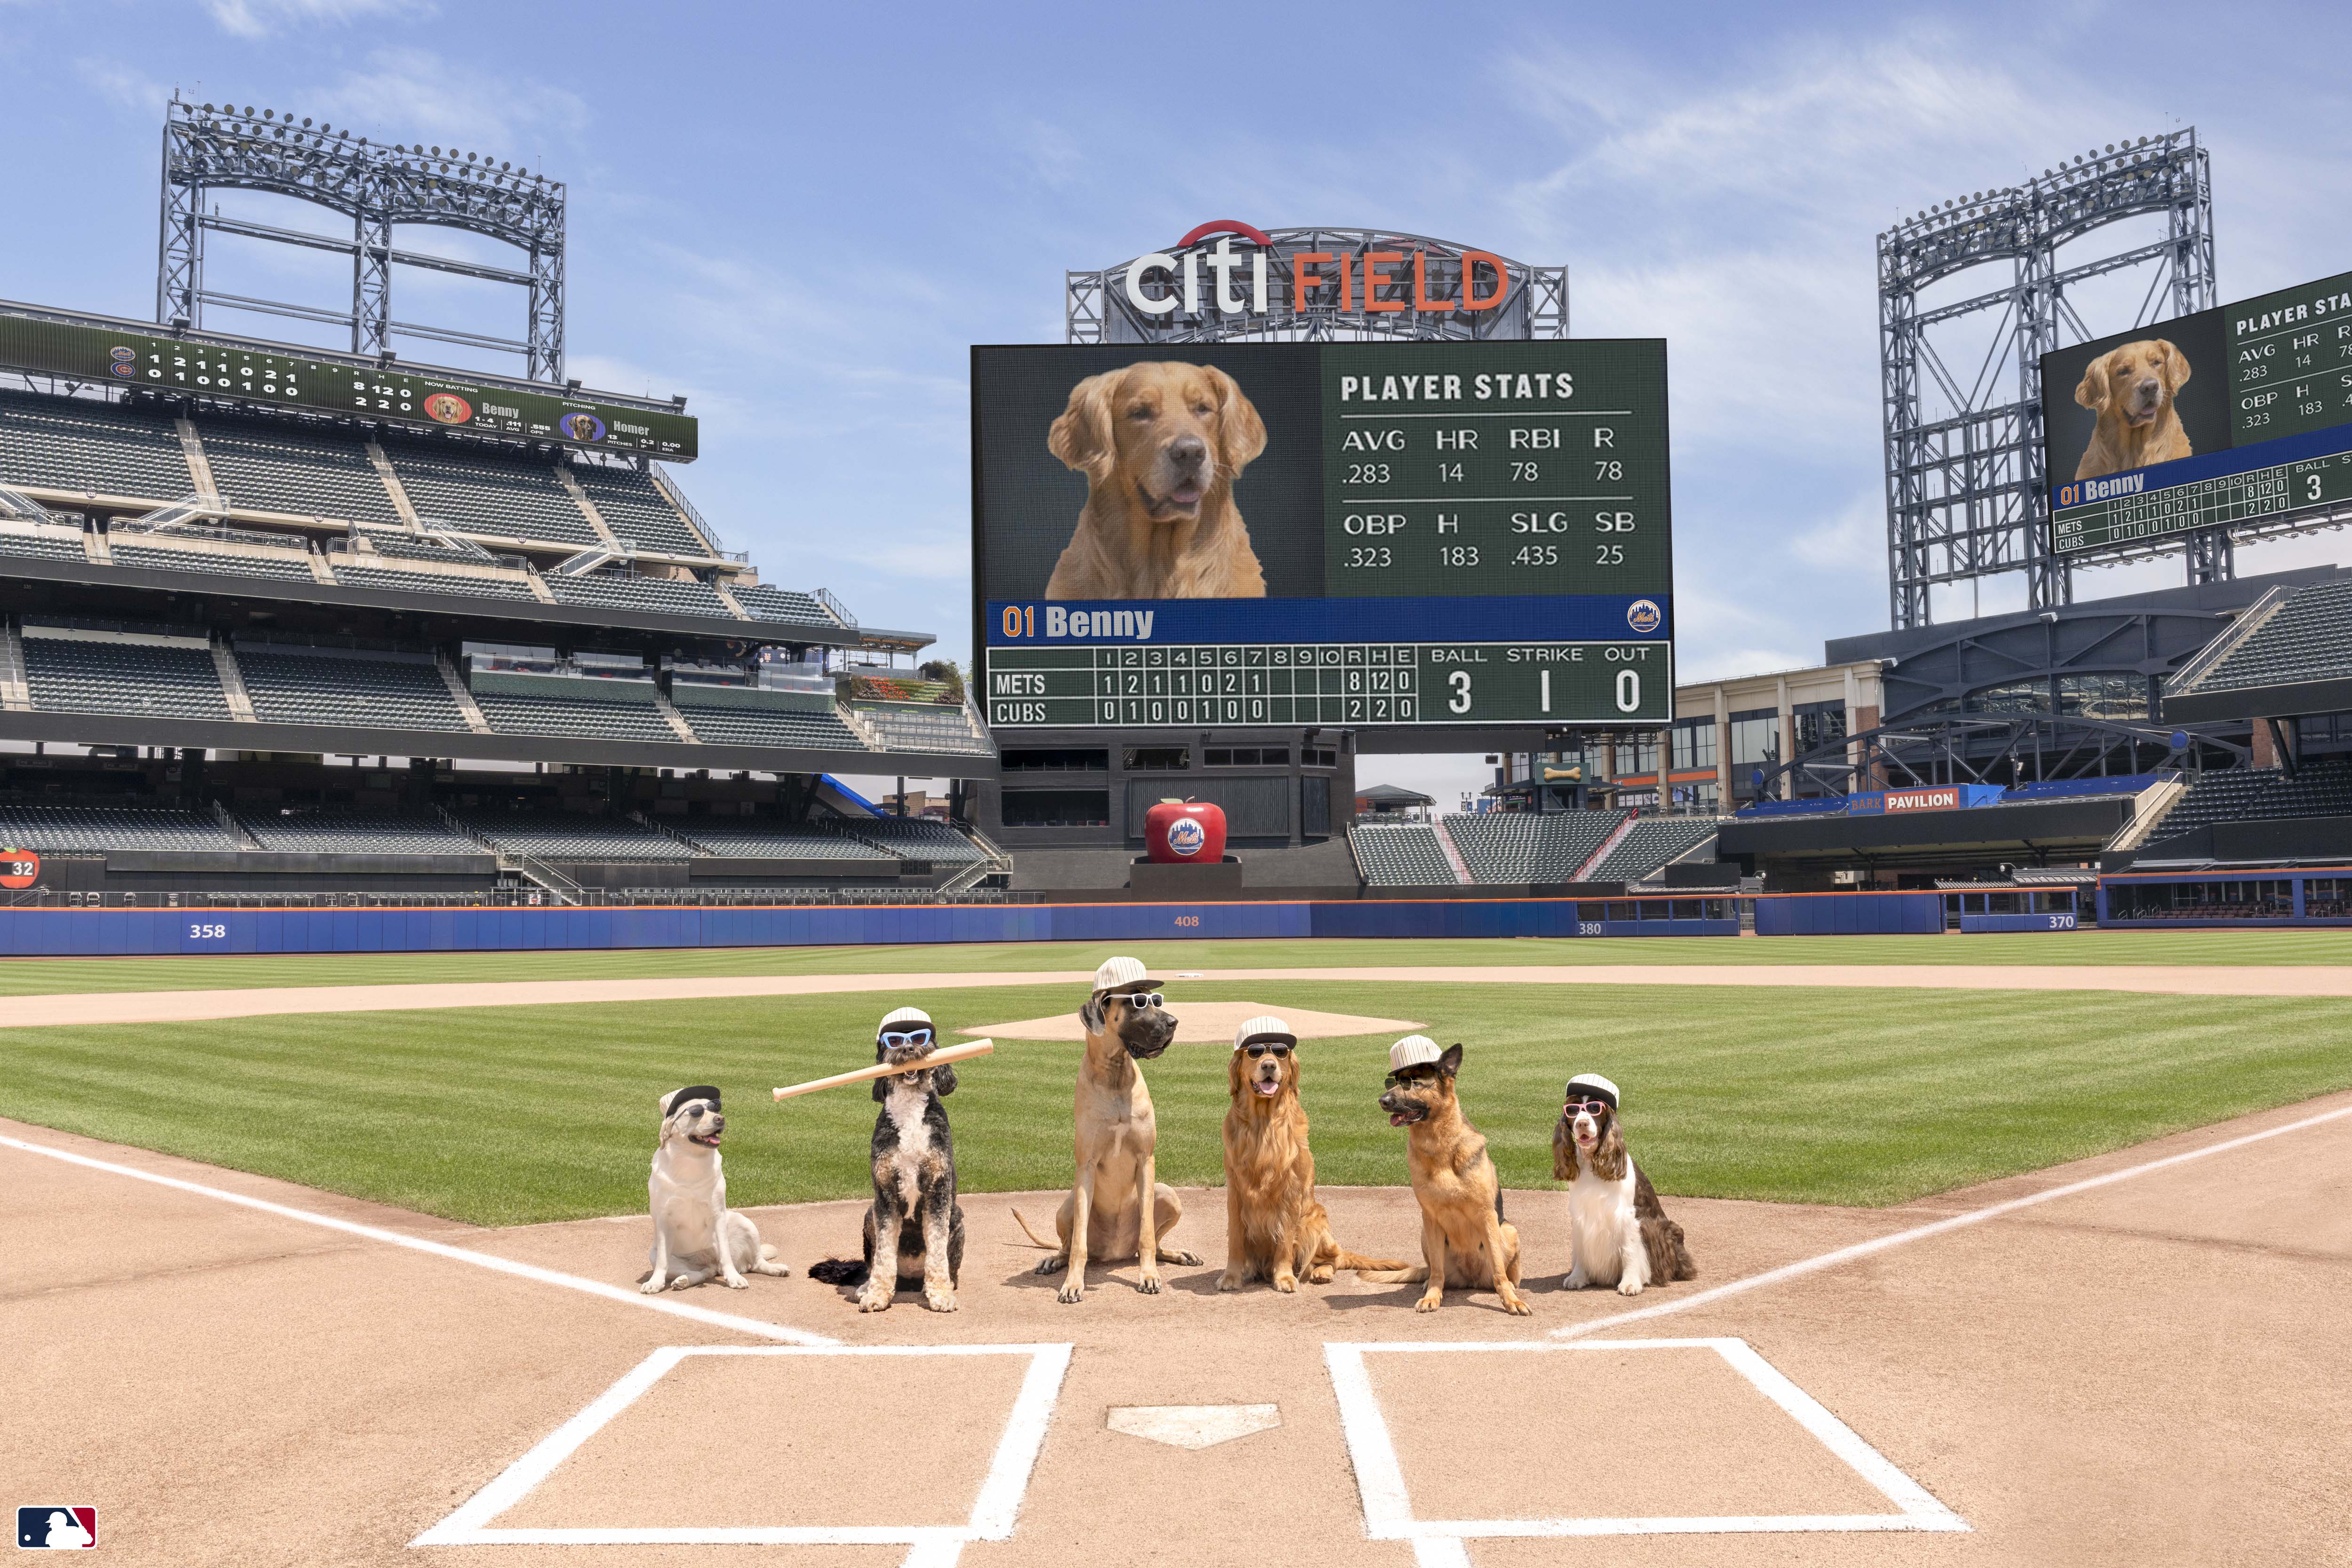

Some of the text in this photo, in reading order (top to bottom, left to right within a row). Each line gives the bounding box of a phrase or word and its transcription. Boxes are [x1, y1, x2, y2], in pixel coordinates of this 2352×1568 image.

[1127, 236, 1508, 314] citi FIELD
[2237, 292, 2352, 335] PLAYER STA
[2239, 325, 2352, 364] AVG HR R
[174, 358, 186, 366] 2
[265, 370, 276, 379] 2
[2240, 365, 2267, 382] .283
[2296, 354, 2311, 367] 14
[218, 378, 230, 387] 0
[263, 384, 276, 393] 0
[372, 385, 393, 395] 12
[1342, 373, 1573, 401] PLAYER STATS
[356, 397, 366, 406] 2
[379, 400, 389, 409] 2
[2241, 392, 2278, 409] OBP
[2296, 384, 2309, 398] H
[483, 403, 518, 418] Benny
[2242, 413, 2270, 429] .323
[2298, 400, 2322, 415] 183
[614, 421, 649, 436] Homer
[1342, 428, 1613, 451] AVG HR RBI R
[1343, 461, 1622, 484] .283 14 78 78
[2296, 455, 2352, 473] BALL S
[2061, 473, 2144, 505] 01 Benny
[2307, 474, 2321, 500] 3
[1344, 512, 1635, 534] OBP H SLG SB
[2058, 520, 2082, 534] METS
[2059, 536, 2084, 549] CUBS
[1344, 545, 1623, 567] .323 183 .435 25
[1003, 606, 1154, 640] 01 Benny
[1633, 612, 1654, 622] Mets
[1125, 652, 1137, 665] 2
[1150, 652, 1162, 665] 3
[1175, 652, 1187, 664] 4
[1200, 652, 1212, 664] 5
[1224, 651, 1237, 664] 6
[1250, 651, 1262, 664] 7
[1274, 651, 1287, 664] 8
[1299, 650, 1312, 664] 9
[1319, 650, 1340, 663] 10
[1348, 650, 1361, 663] R
[1373, 650, 1387, 663] H
[1398, 650, 1410, 663] E
[1431, 647, 1650, 662] BALL STRIKE OUT
[997, 671, 1409, 694] METS 1 2 1 1 0 2 1 8 12 0
[1449, 671, 1471, 713] 3
[1616, 669, 1640, 712] 0
[997, 699, 1411, 722] CUBS 0 1 0 0 1 0 0 2 2 0
[1851, 793, 1953, 811] BARK PAVILION
[1173, 831, 1199, 844] Mets
[13, 862, 33, 875] 32
[1174, 916, 1200, 927] 408
[1580, 923, 1601, 934] 380
[2050, 916, 2074, 928] 370
[191, 925, 225, 938] 358
